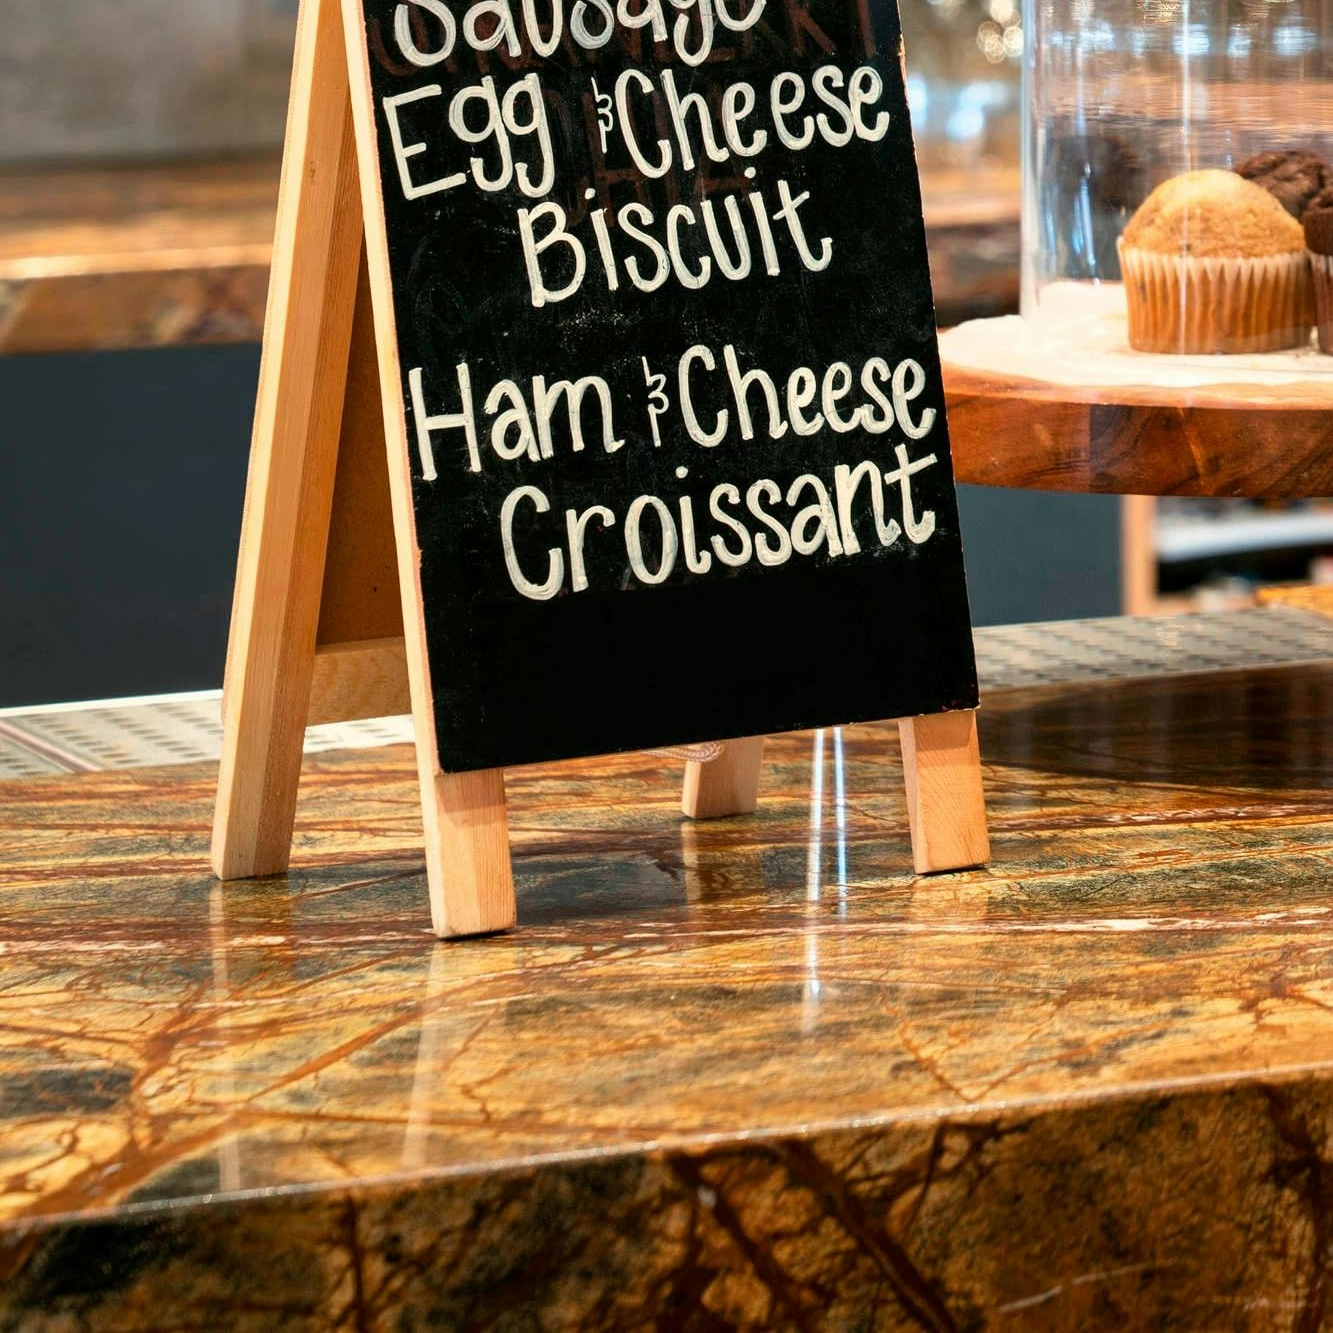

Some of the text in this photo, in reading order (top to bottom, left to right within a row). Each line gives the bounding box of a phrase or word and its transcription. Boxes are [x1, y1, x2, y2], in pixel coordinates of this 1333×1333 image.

[383, 73, 555, 200] Egg
[614, 65, 890, 179] Cheese
[517, 167, 833, 308] Biscuit
[408, 362, 625, 481] Ham
[678, 344, 937, 450] Cheese
[500, 444, 939, 601] Croissant
